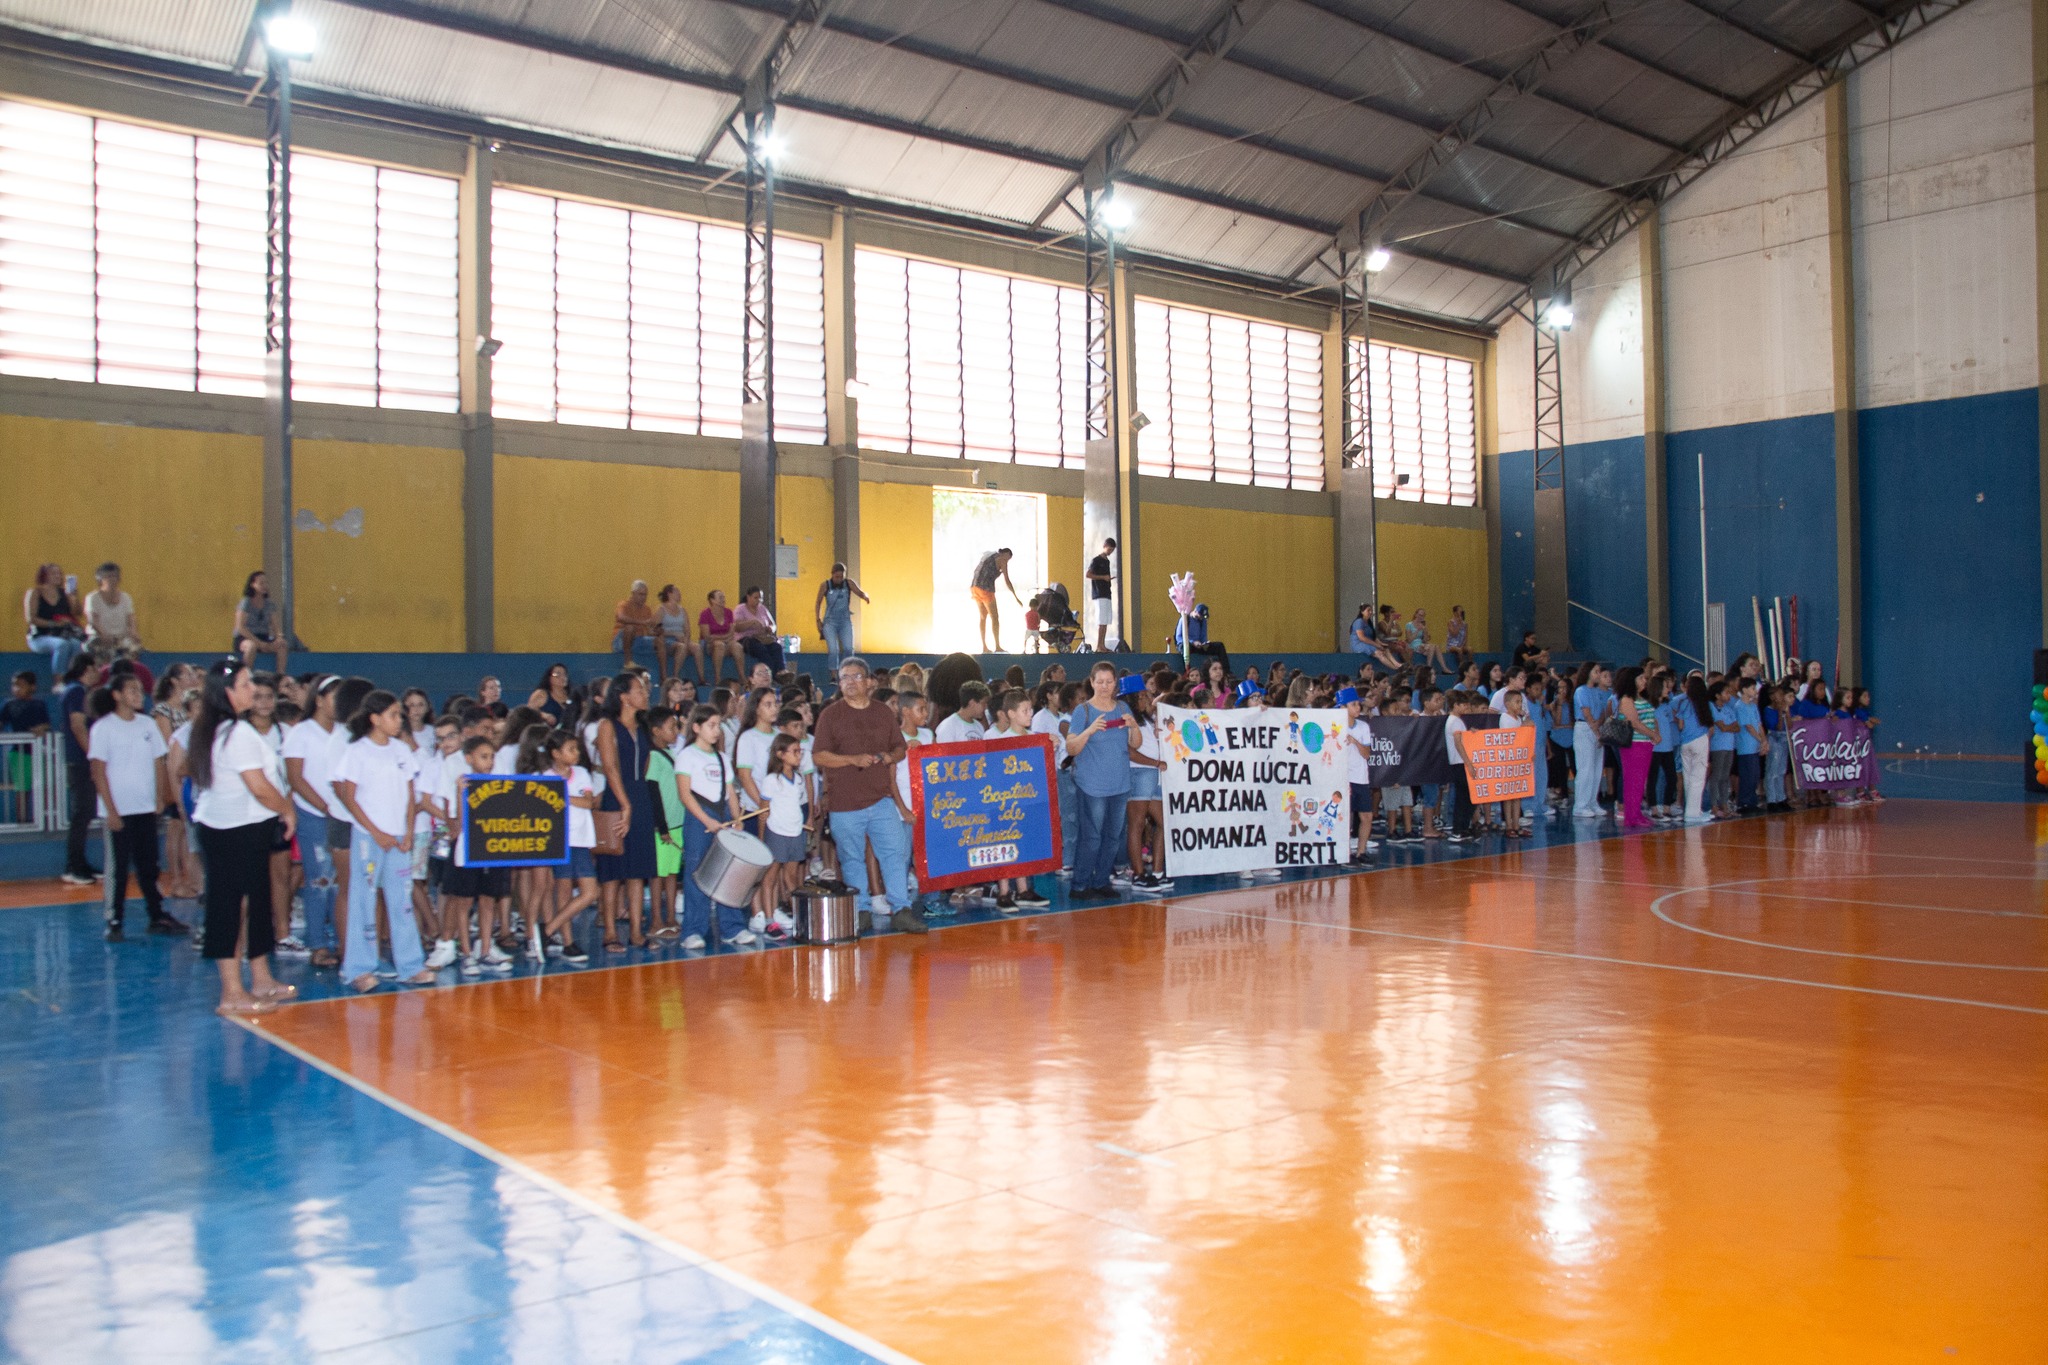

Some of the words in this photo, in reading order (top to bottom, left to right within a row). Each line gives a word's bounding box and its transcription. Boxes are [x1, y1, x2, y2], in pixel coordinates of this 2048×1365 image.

[1484, 732, 1516, 746] EMEF
[1382, 751, 1401, 766] Vida
[1472, 747, 1529, 763] ATEMARO
[1253, 755, 1312, 785] LÚCIA
[1801, 761, 1862, 783] Reviver
[468, 780, 516, 809] EMEF
[1475, 783, 1489, 797] DE
[1495, 779, 1529, 795] SOUZA
[999, 801, 1025, 821] de
[1168, 788, 1268, 815] MARIANA
[1171, 824, 1267, 853] ROMANIA
[1275, 841, 1338, 865] BERTI
